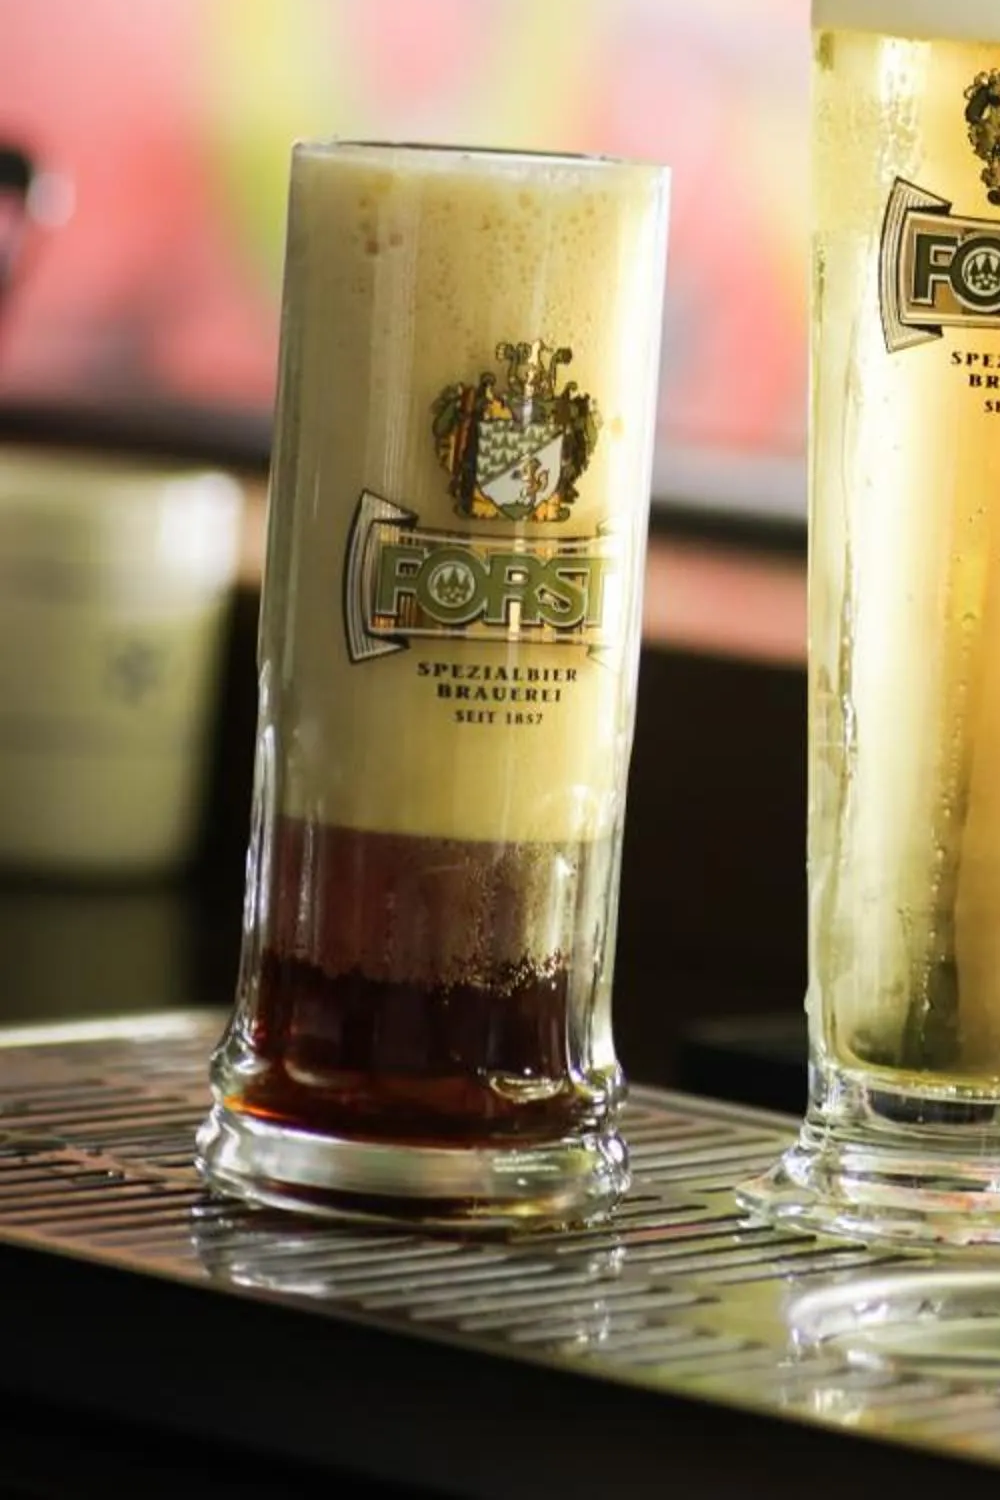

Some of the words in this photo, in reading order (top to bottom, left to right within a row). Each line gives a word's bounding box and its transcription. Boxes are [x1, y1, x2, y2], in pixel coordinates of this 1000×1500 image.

[374, 544, 616, 630] FORST
[416, 660, 579, 684] SPEZIALBIER
[436, 682, 562, 704] BRAUEREI
[454, 708, 495, 726] SEIT
[505, 711, 544, 727] 1857
